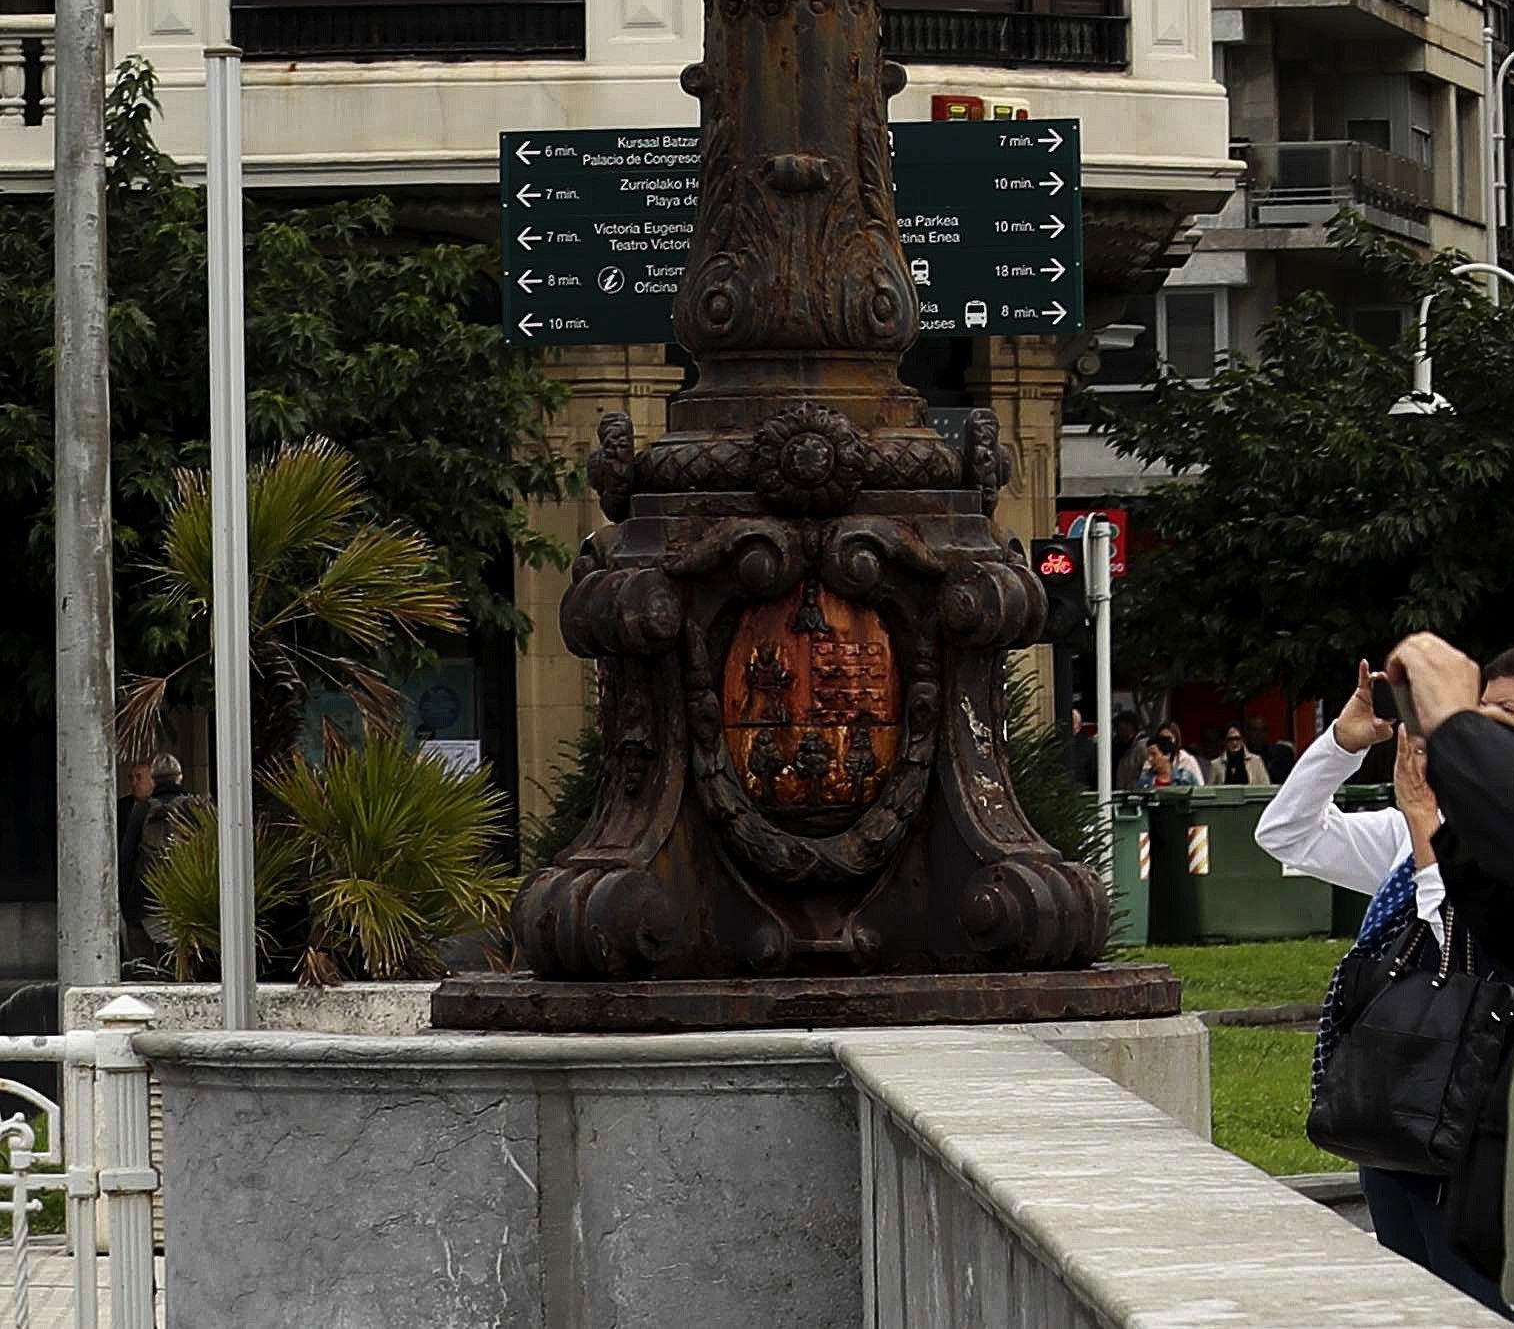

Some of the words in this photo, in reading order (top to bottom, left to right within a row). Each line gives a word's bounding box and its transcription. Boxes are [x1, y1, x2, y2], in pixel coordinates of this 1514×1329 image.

[545, 145, 553, 157] 6
[554, 145, 578, 157] min.
[617, 137, 660, 149] Kursaal
[1000, 136, 1007, 147] 7
[1009, 135, 1034, 147] min.
[582, 154, 624, 166] Palacio
[626, 153, 641, 165] de
[620, 178, 682, 191] Zurriolako
[994, 178, 1008, 190] 10
[1010, 178, 1035, 190] min.
[546, 189, 553, 200] 7
[555, 188, 580, 200] min.
[646, 194, 681, 209] Playa
[593, 222, 641, 235] Victoria
[644, 222, 694, 236] Eugenia
[915, 214, 959, 227] Parkea
[994, 221, 1008, 233] 10
[1010, 220, 1035, 232] min.
[547, 232, 554, 243] 7
[556, 231, 581, 242] min.
[609, 239, 648, 251] Teatro
[650, 238, 691, 250] Victori
[928, 230, 960, 243] Enea
[995, 265, 1009, 277] 18
[1011, 264, 1036, 276] min.
[547, 275, 555, 286] 8
[557, 274, 582, 286] min.
[634, 281, 678, 295] Oficina
[1001, 305, 1009, 317] 8
[1013, 306, 1039, 318] min.
[549, 318, 563, 330] 10
[565, 317, 590, 330] min.
